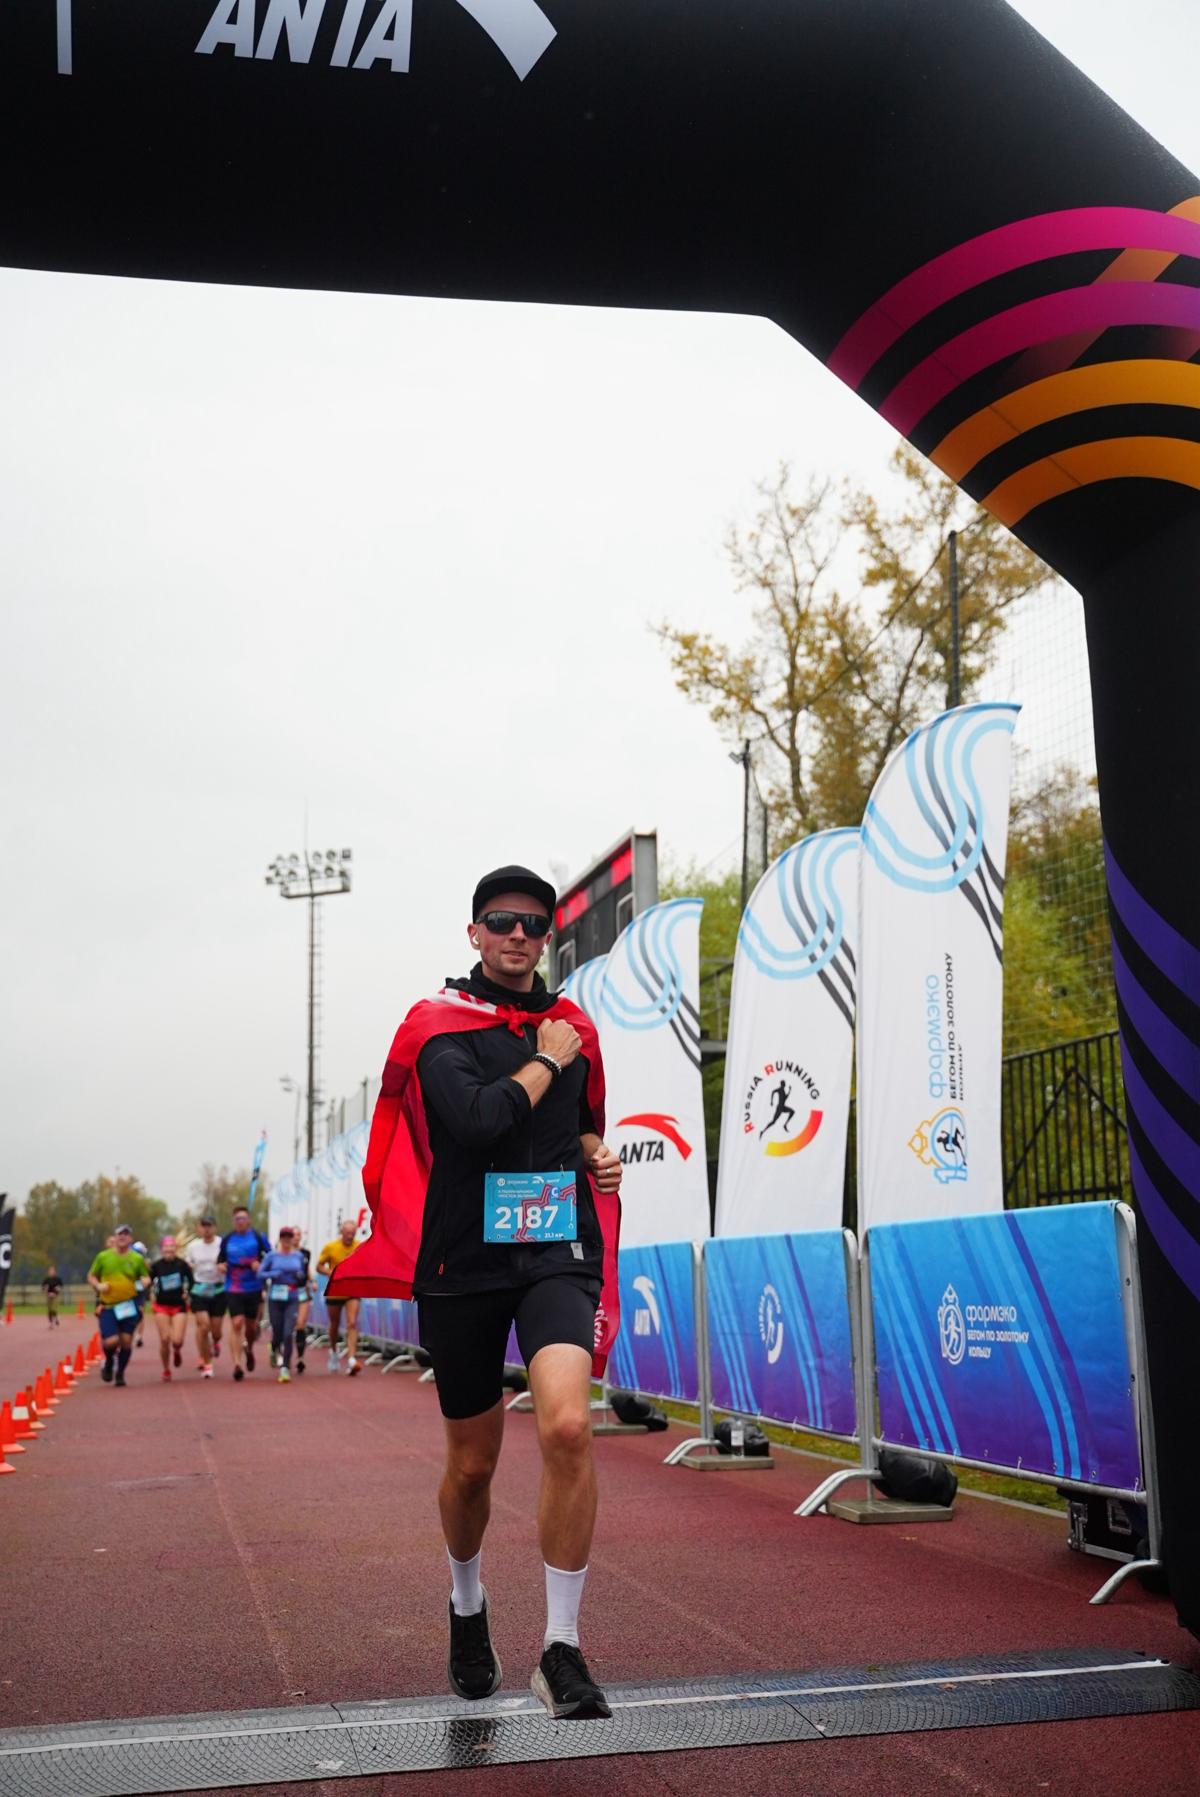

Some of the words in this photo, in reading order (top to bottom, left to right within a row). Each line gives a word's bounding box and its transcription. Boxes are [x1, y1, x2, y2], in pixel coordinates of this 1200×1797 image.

[945, 953, 955, 1027] ЗОЛОТОМУ
[926, 974, 947, 1099] фармэко
[948, 1031, 956, 1051] ПО
[744, 1076, 763, 1134] RUSSIA
[764, 1060, 820, 1101] RUNNING
[948, 1054, 957, 1099] БЕГОМ
[618, 1140, 664, 1165] ANTA
[494, 1205, 558, 1229] 2187
